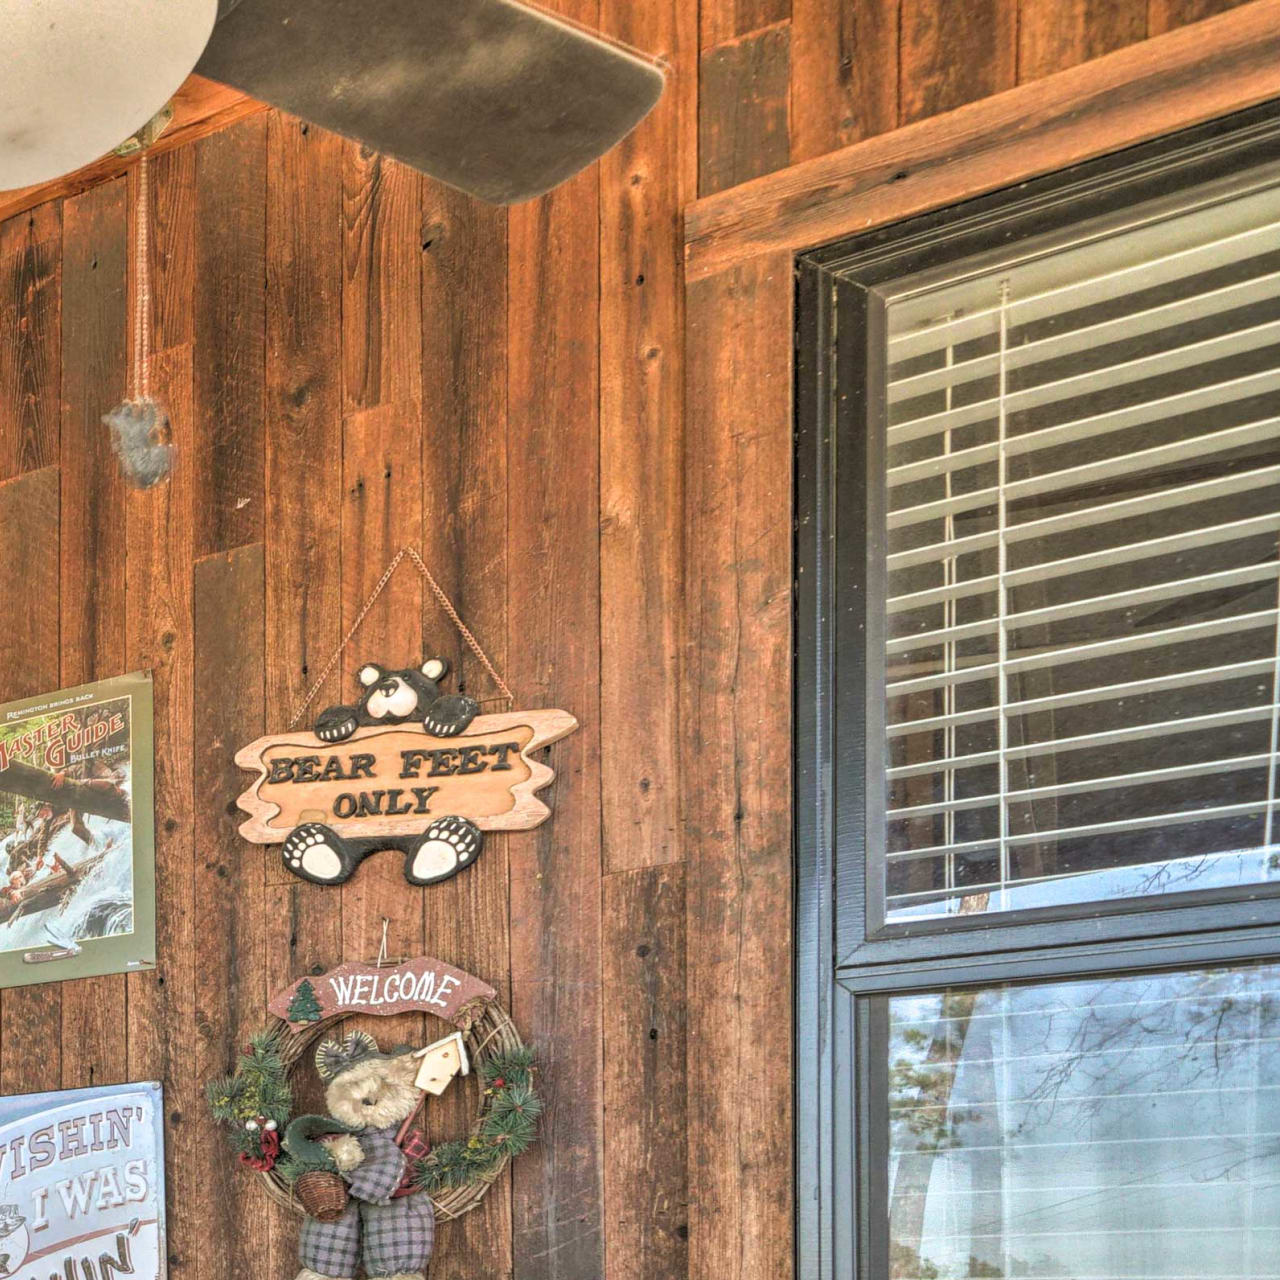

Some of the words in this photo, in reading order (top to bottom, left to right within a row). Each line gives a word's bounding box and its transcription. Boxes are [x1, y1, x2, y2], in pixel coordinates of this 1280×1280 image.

[7, 704, 48, 720] REMINGTON
[49, 698, 74, 709] BRINGS
[75, 693, 94, 702] BACK
[44, 712, 125, 768] GUIDE
[69, 749, 100, 764] BULLET
[101, 744, 126, 757] KNIFE
[267, 748, 376, 784] BEAR
[399, 742, 521, 779] FEET
[333, 786, 439, 819] ONLY
[330, 969, 461, 1008] WELCOME
[30, 1187, 49, 1233] I
[55, 1157, 149, 1220] WAS
